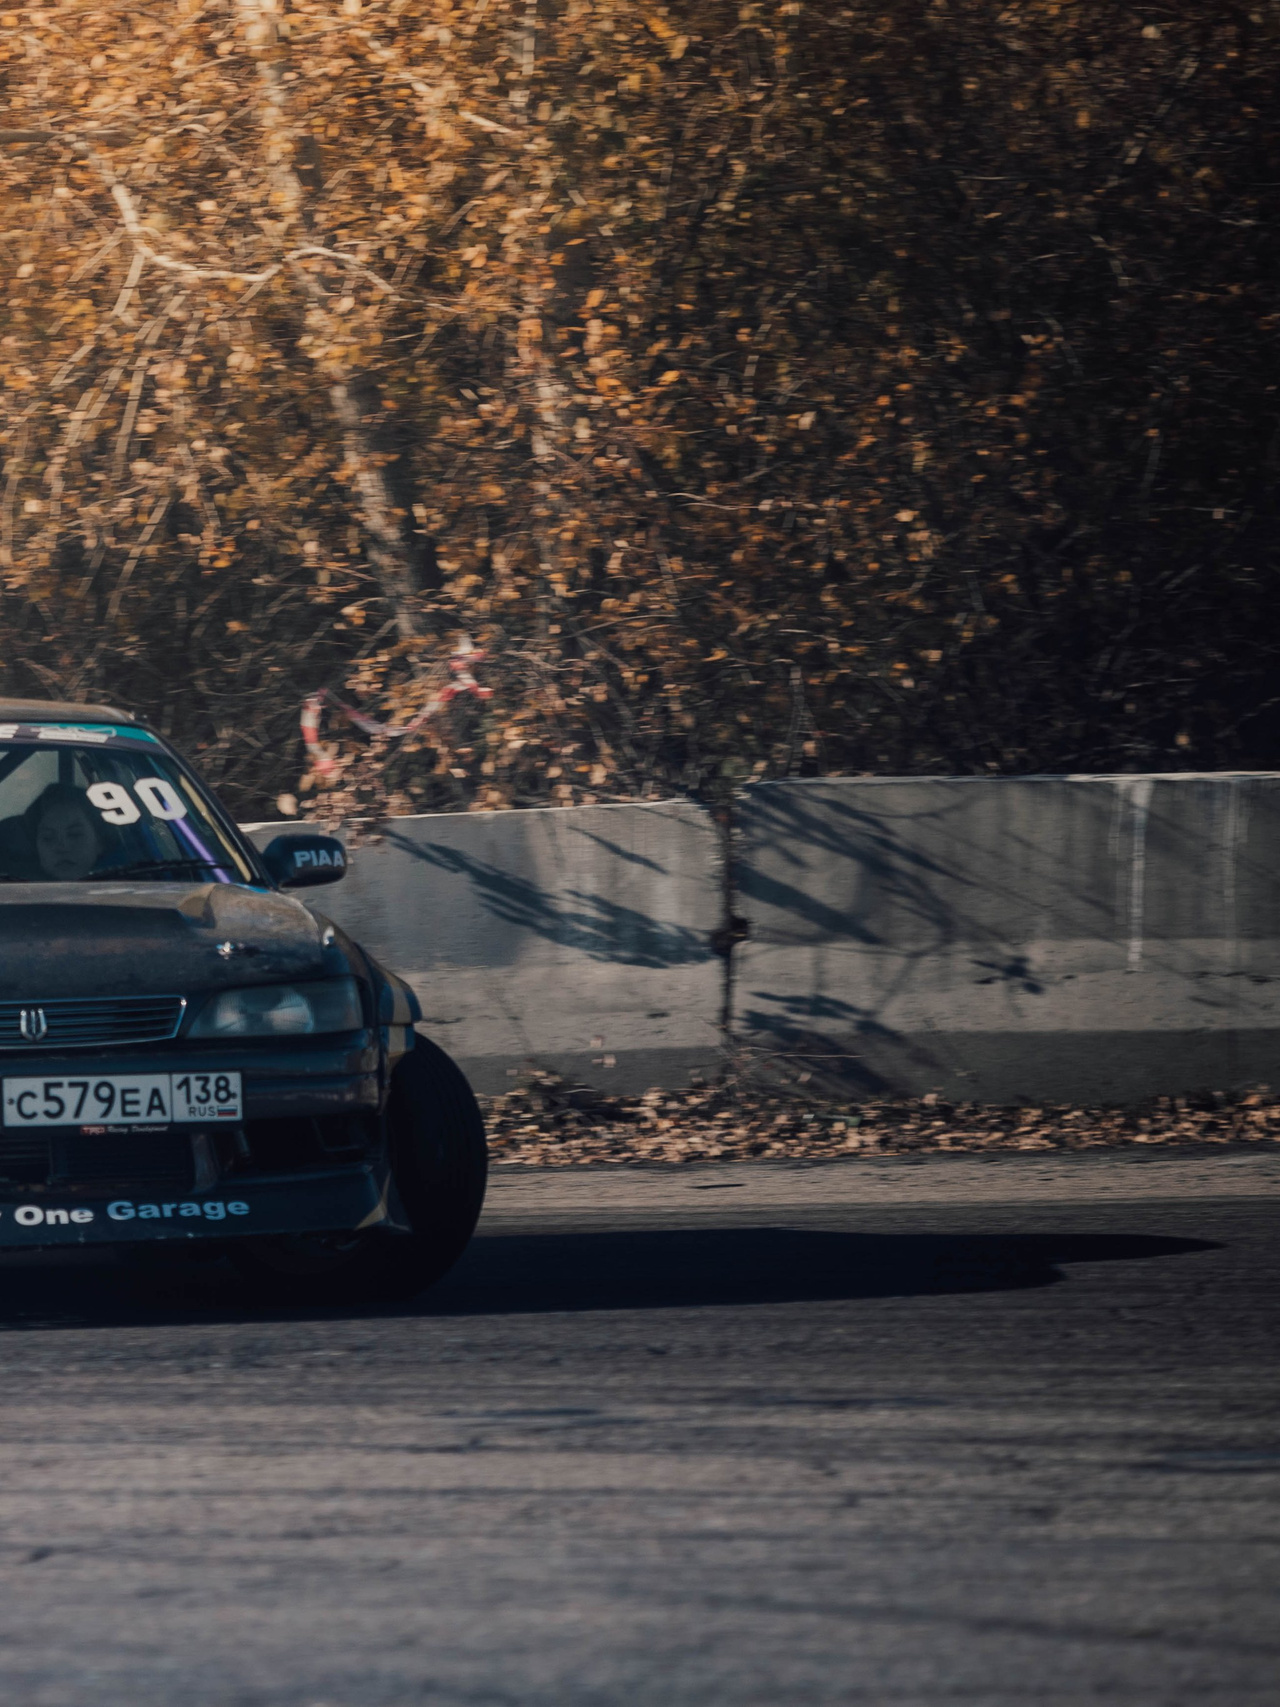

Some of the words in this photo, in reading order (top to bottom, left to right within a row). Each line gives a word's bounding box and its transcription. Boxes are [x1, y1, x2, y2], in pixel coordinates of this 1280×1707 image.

[86, 777, 187, 825] 90
[294, 849, 344, 867] PIAA
[16, 1082, 167, 1119] C579EA
[177, 1076, 231, 1104] 138
[189, 1106, 216, 1116] RUS
[14, 1205, 94, 1226] One
[107, 1201, 250, 1222] Garage
